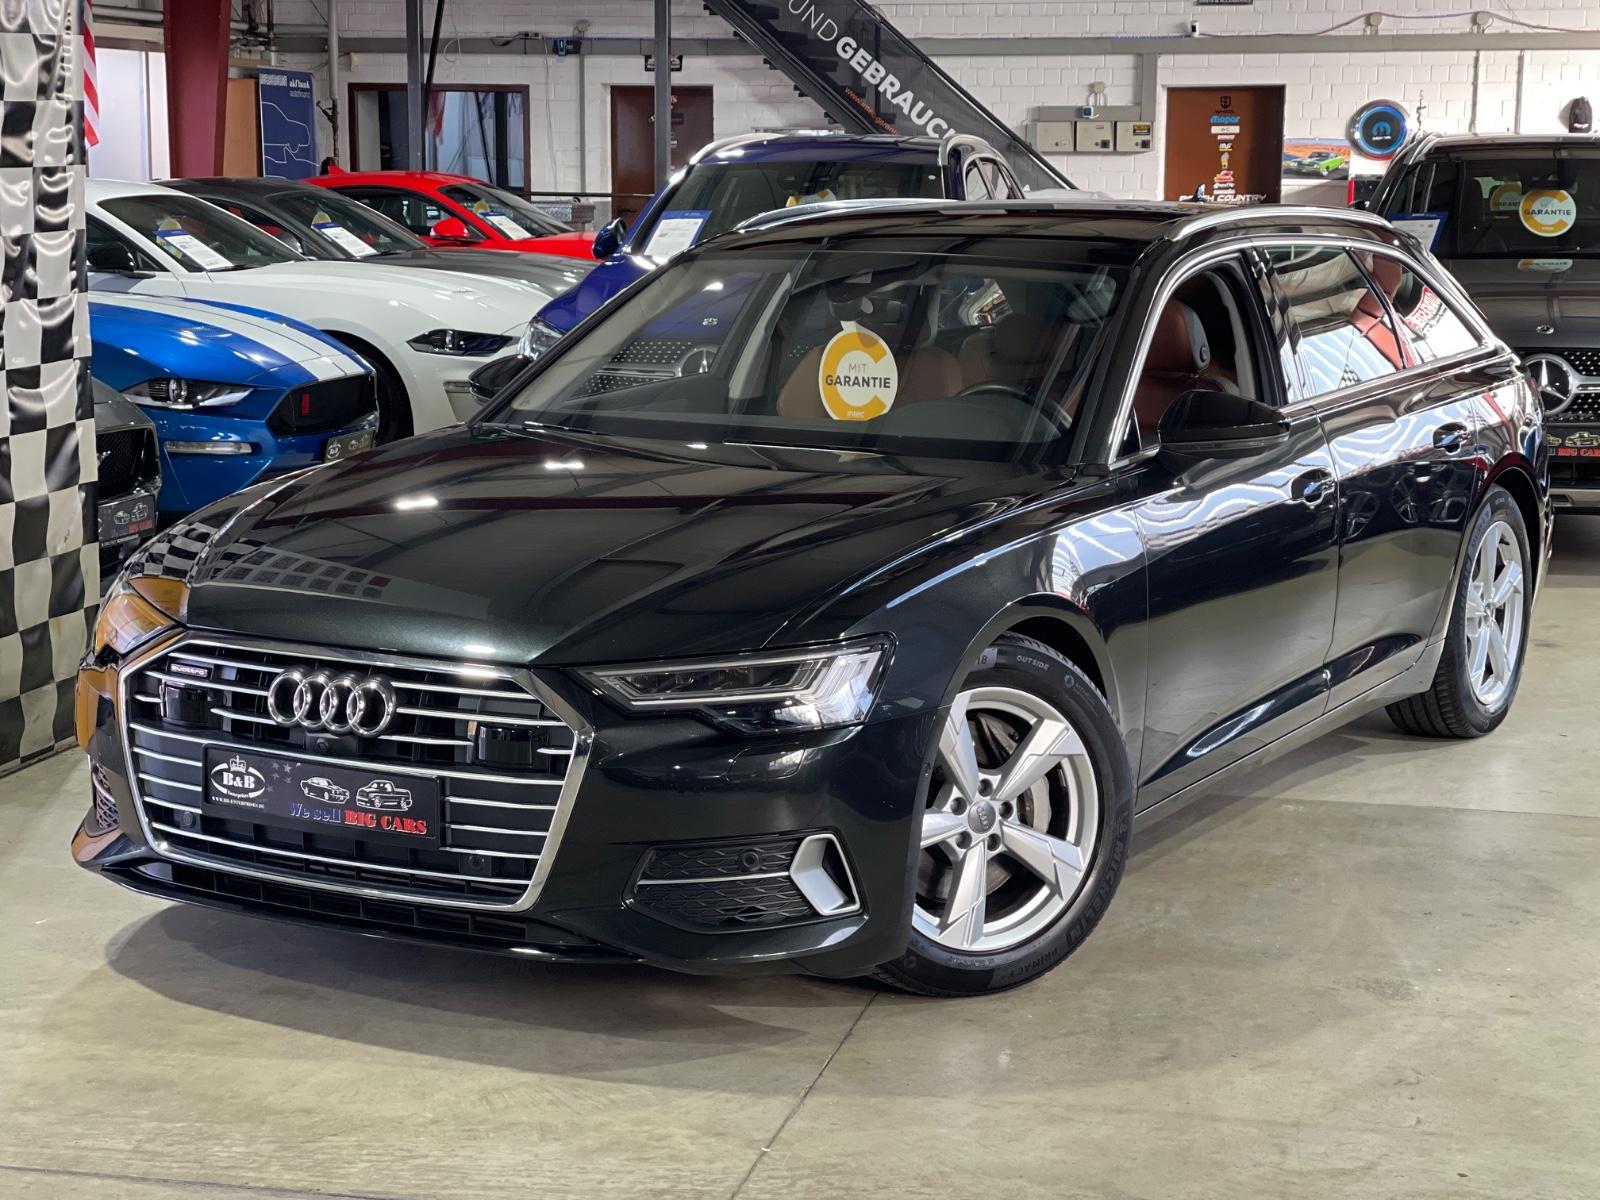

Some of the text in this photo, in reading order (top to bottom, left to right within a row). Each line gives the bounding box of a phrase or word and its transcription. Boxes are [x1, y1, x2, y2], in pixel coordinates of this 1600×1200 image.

[788, 0, 838, 41] UND
[1216, 194, 1267, 202] COUNTRY
[1523, 208, 1572, 216] GARANTIE
[848, 363, 867, 374] MIT
[825, 374, 891, 389] GARANTIE
[1016, 655, 1050, 671] OUTSIDE
[222, 771, 255, 789] B&B
[288, 803, 428, 835] We sell BIG CARS
